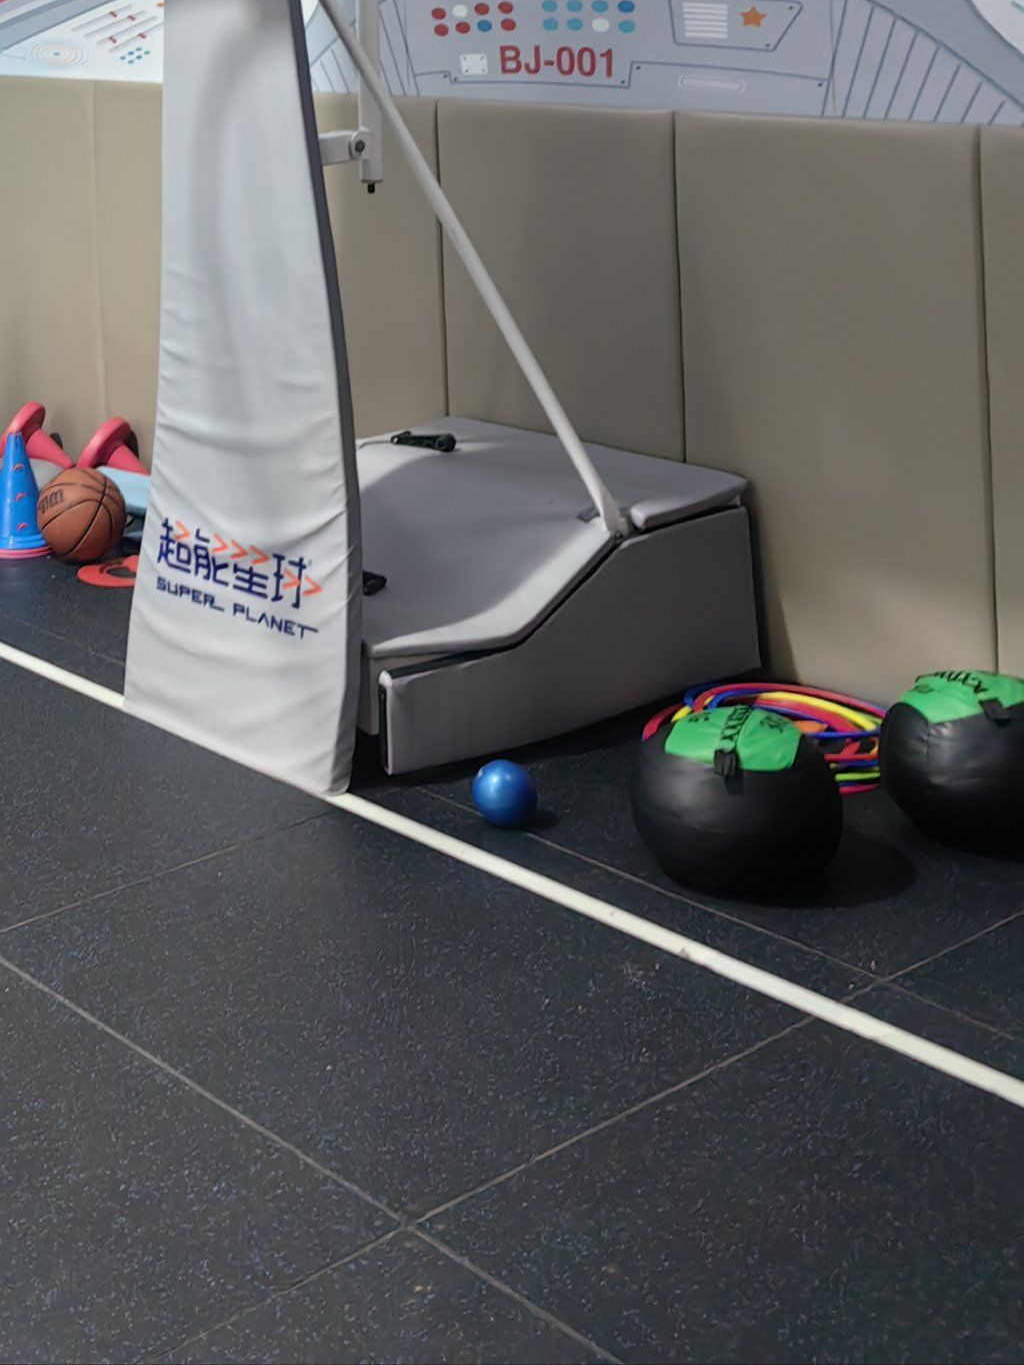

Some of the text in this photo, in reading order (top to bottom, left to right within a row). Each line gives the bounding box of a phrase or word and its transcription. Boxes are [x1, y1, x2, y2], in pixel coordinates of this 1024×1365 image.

[499, 44, 613, 79] BJ-001
[156, 576, 319, 639] SUPER PLANET
